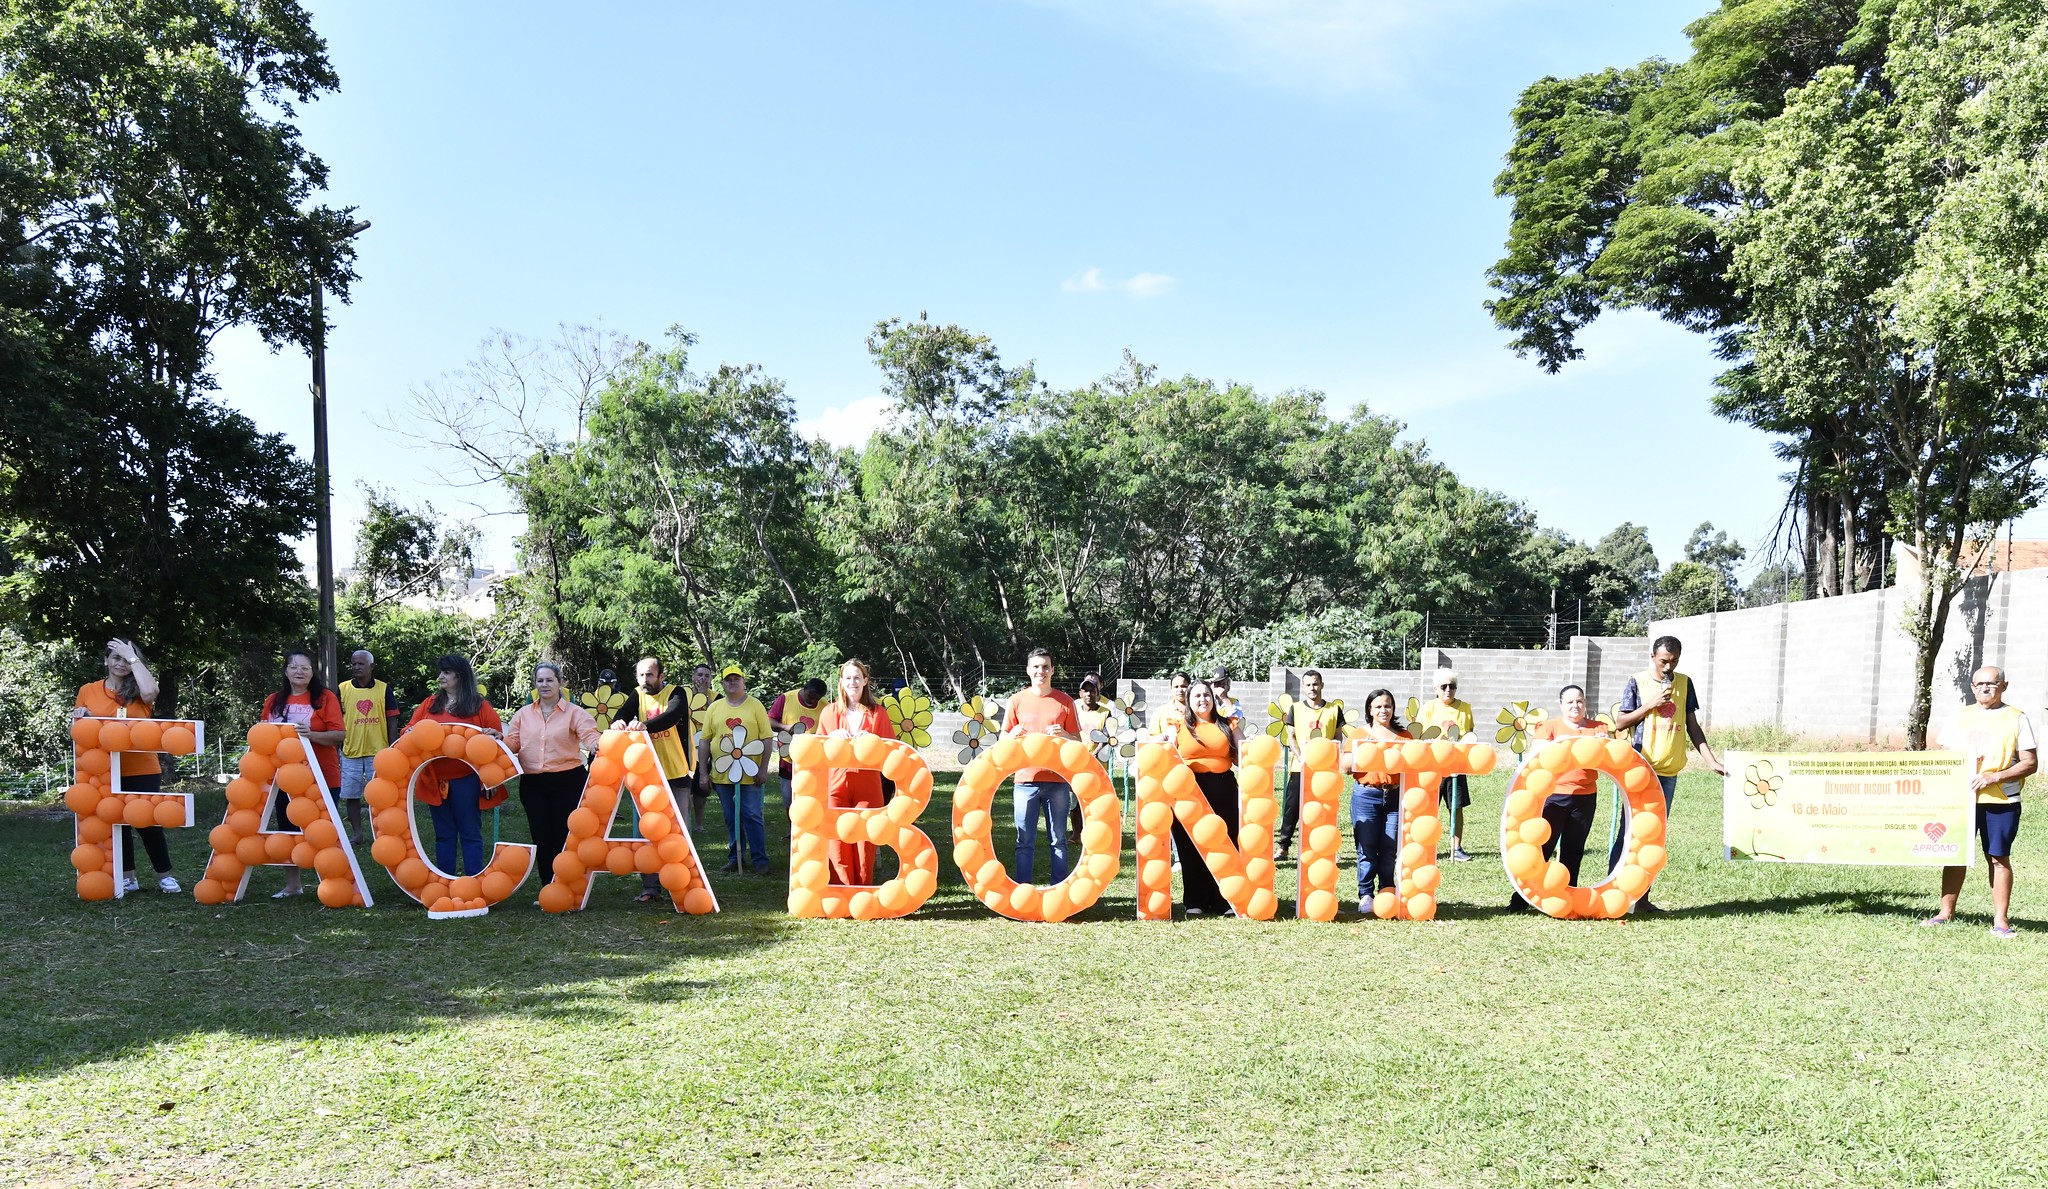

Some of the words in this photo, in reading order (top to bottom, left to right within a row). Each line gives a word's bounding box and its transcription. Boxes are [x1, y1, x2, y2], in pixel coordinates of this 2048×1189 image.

[1791, 802, 1803, 815] 18
[1805, 802, 1819, 816] de
[1822, 802, 1848, 816] Maio
[787, 732, 1668, 922] BONITO
[1884, 823, 1906, 831] DISQUE
[1911, 843, 1959, 853] APROMO
